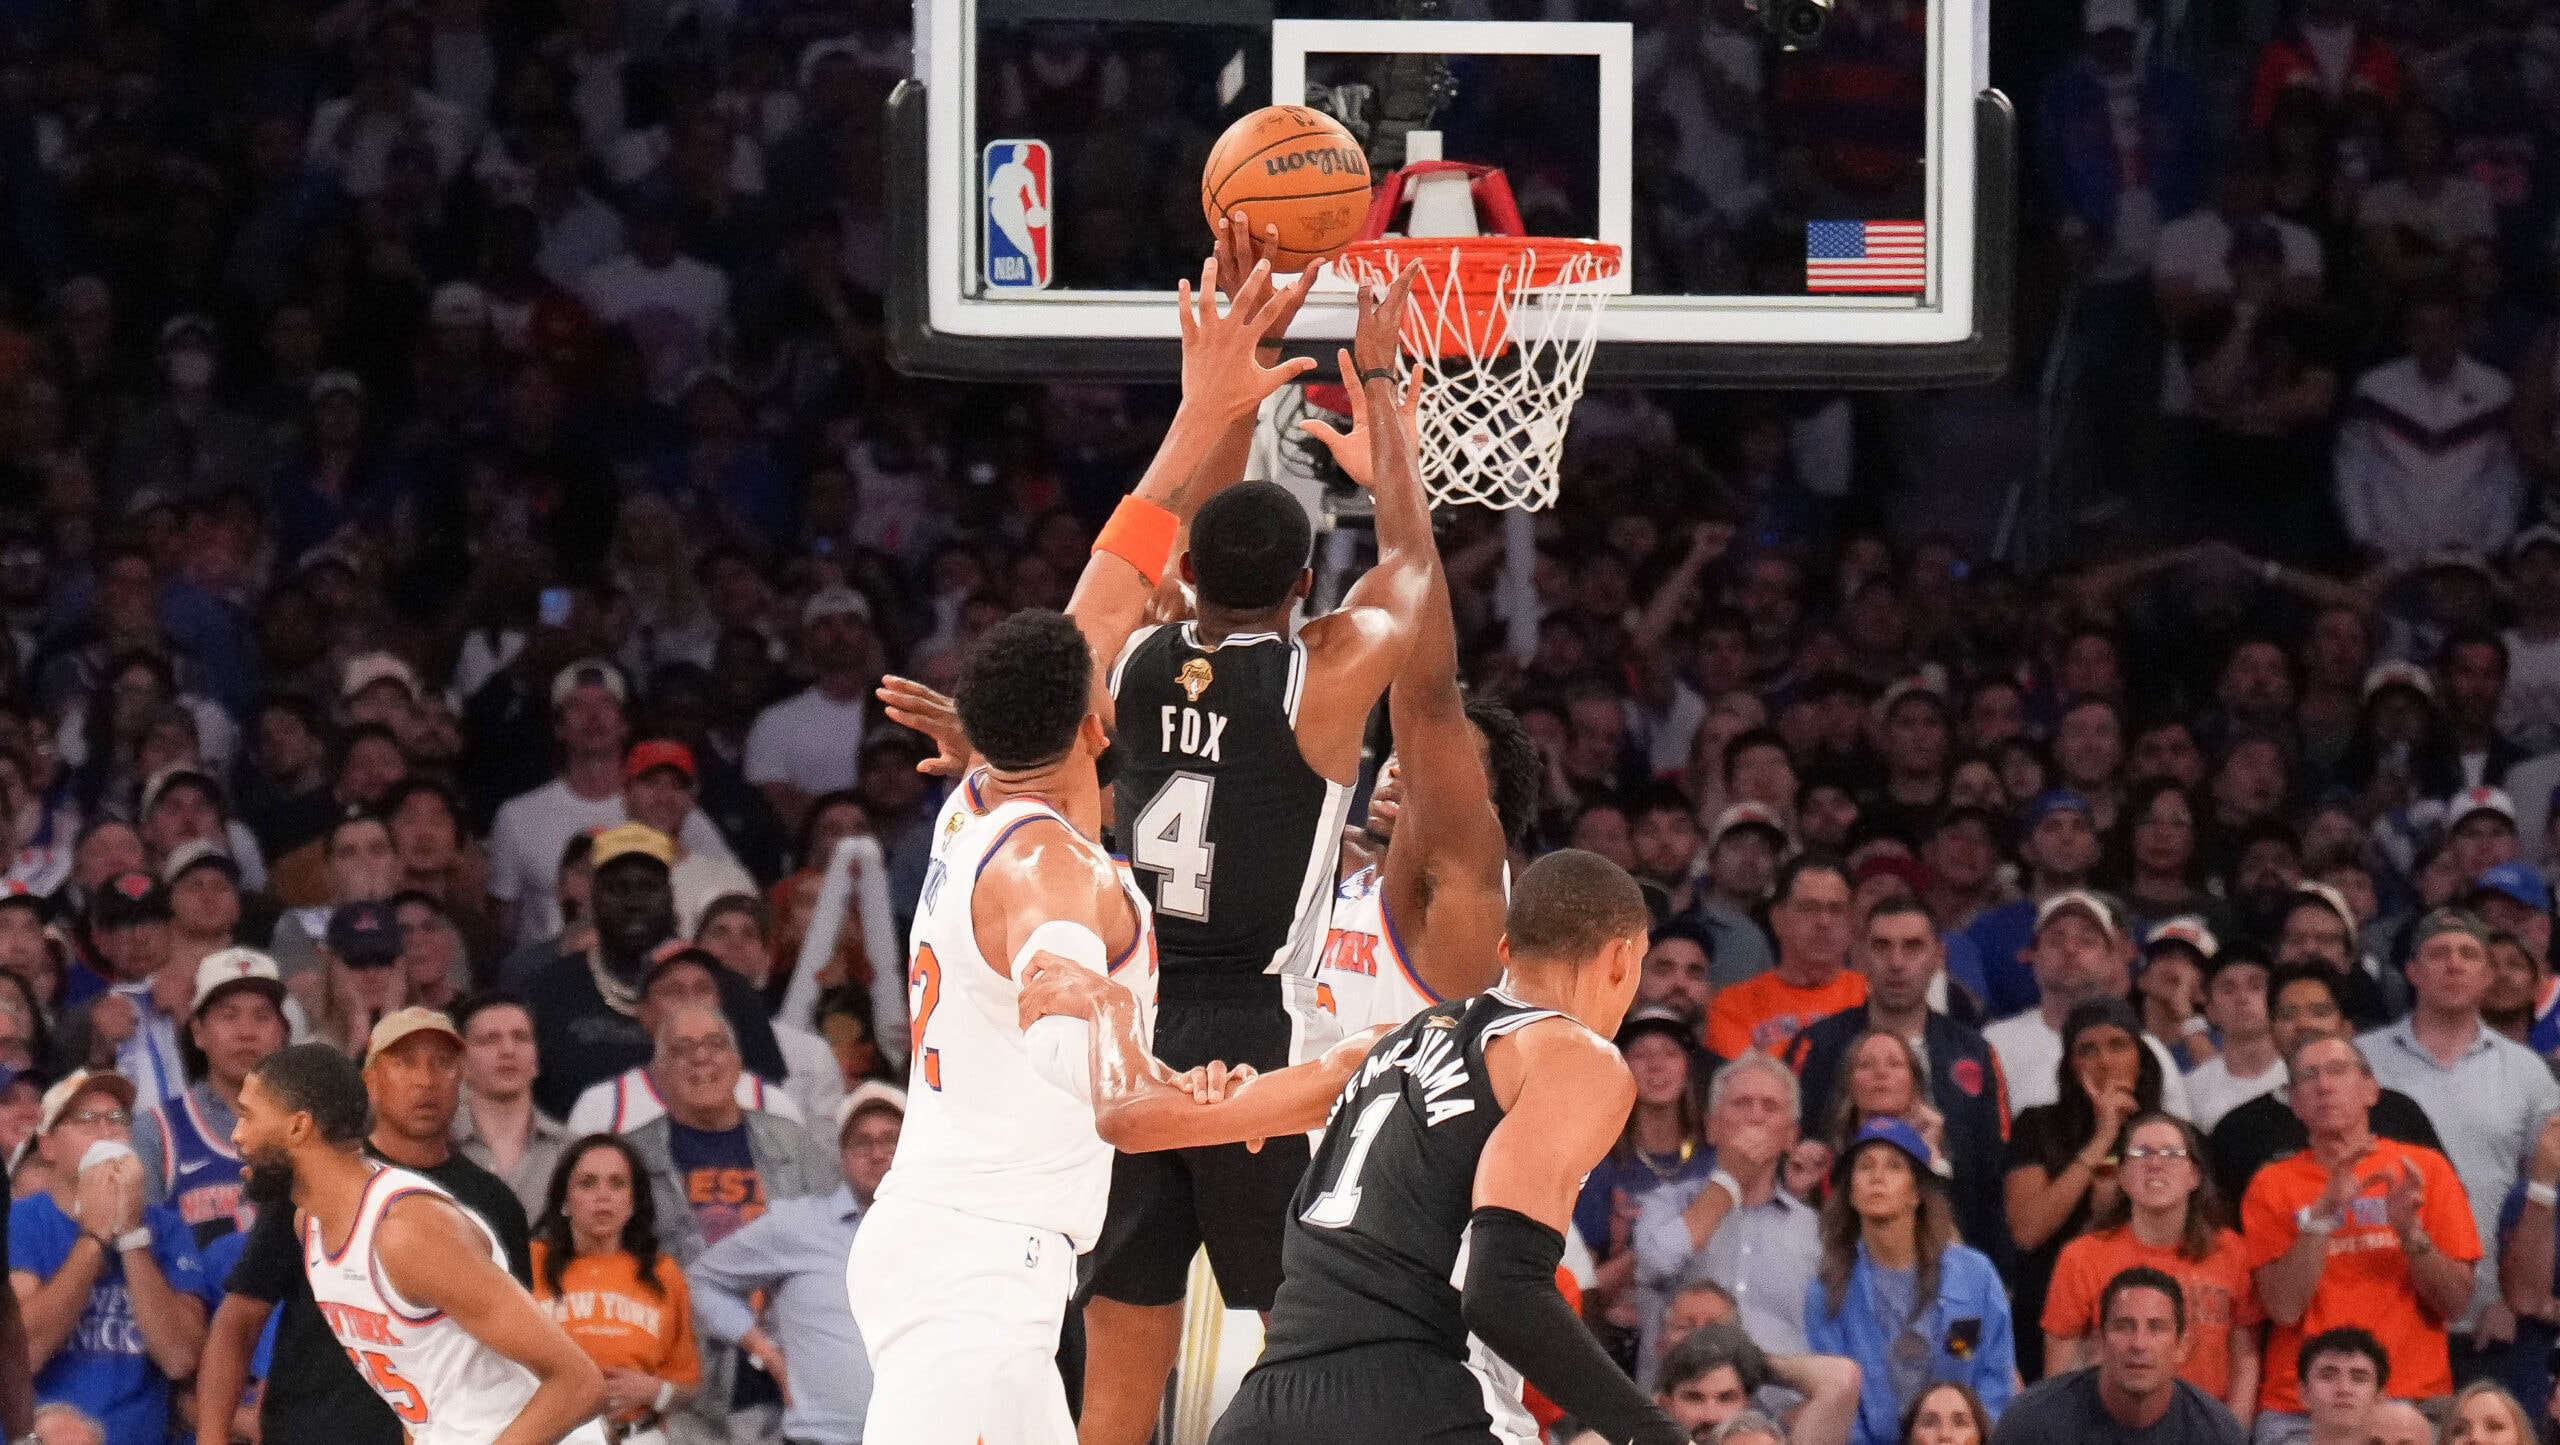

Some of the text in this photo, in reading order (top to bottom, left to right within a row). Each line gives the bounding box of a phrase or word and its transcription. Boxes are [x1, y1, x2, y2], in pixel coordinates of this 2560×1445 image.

[1264, 147, 1366, 176] Wilson
[994, 256, 1026, 280] NBA
[1161, 705, 1228, 763] FOX
[1133, 770, 1216, 923] 4
[908, 940, 943, 1092] 2
[1300, 1092, 1401, 1219] 1
[601, 1291, 661, 1339] YORK
